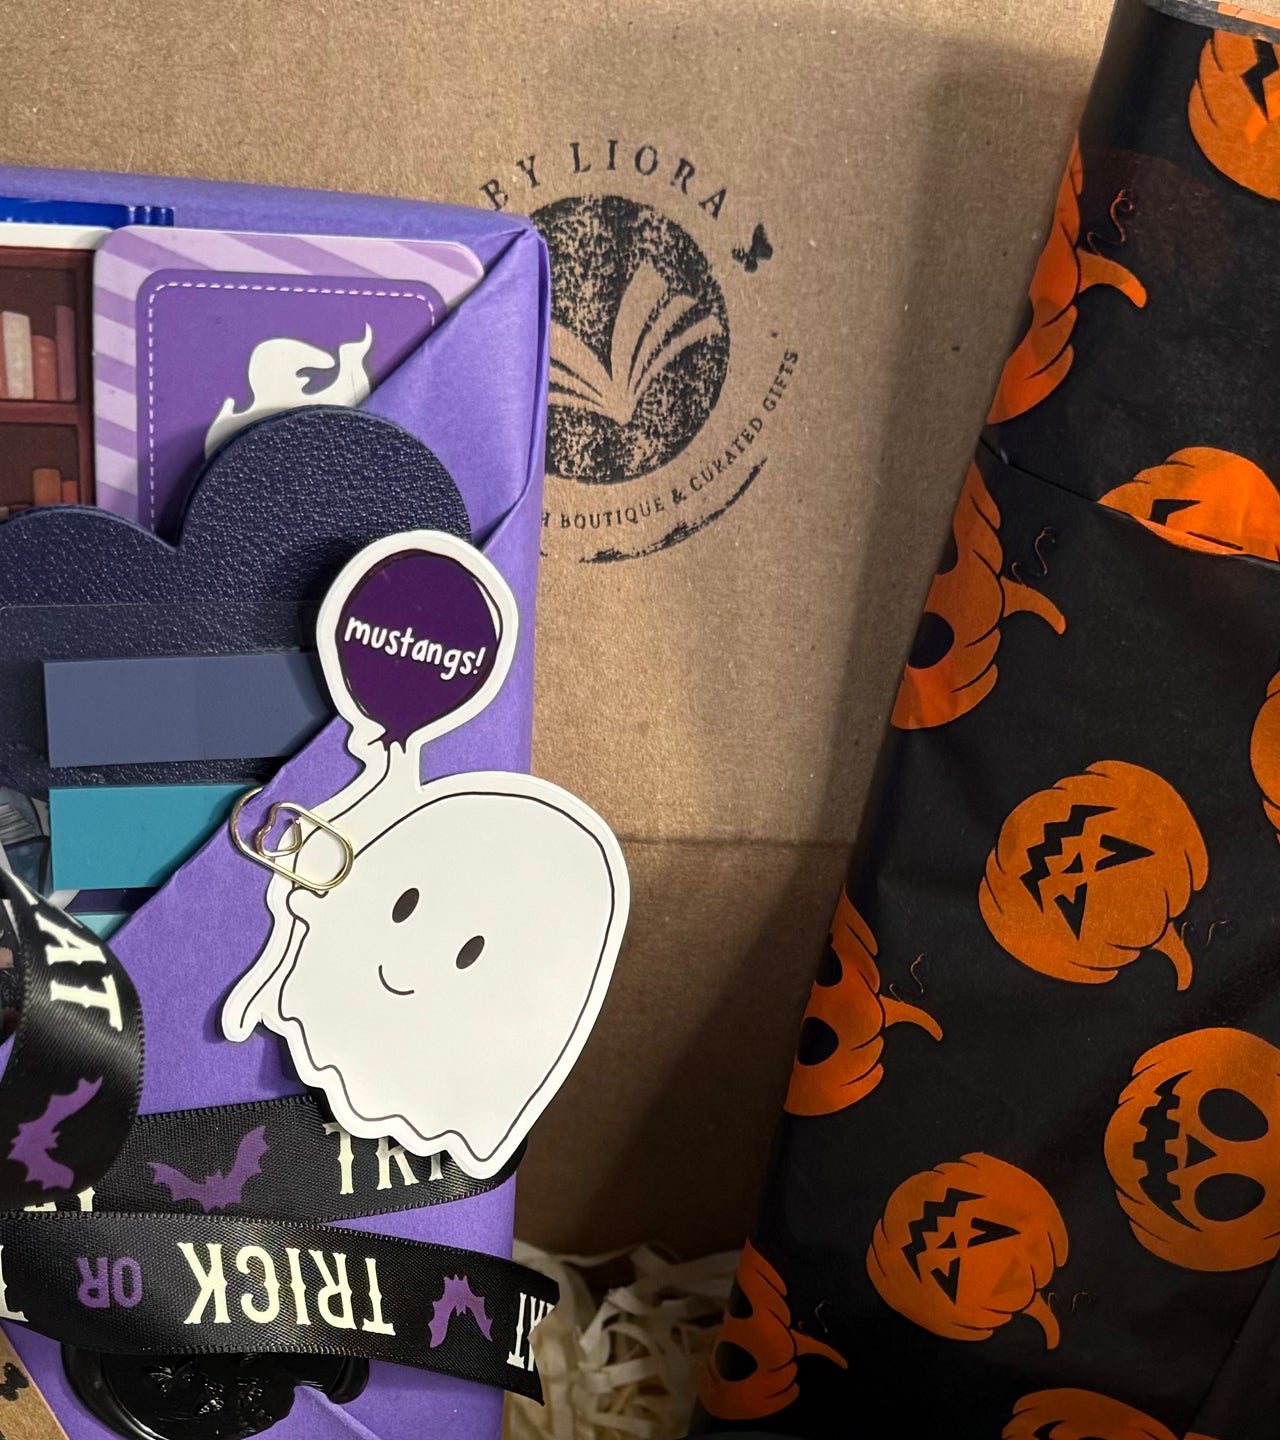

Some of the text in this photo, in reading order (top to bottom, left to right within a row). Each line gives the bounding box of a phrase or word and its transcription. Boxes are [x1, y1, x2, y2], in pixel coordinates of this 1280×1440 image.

[480, 139, 728, 221] BY LIORA
[561, 350, 799, 529] BOUTIQUE & CURATED GIFTS
[345, 615, 486, 680] mustangs!
[77, 1241, 397, 1336] OR TRICK
